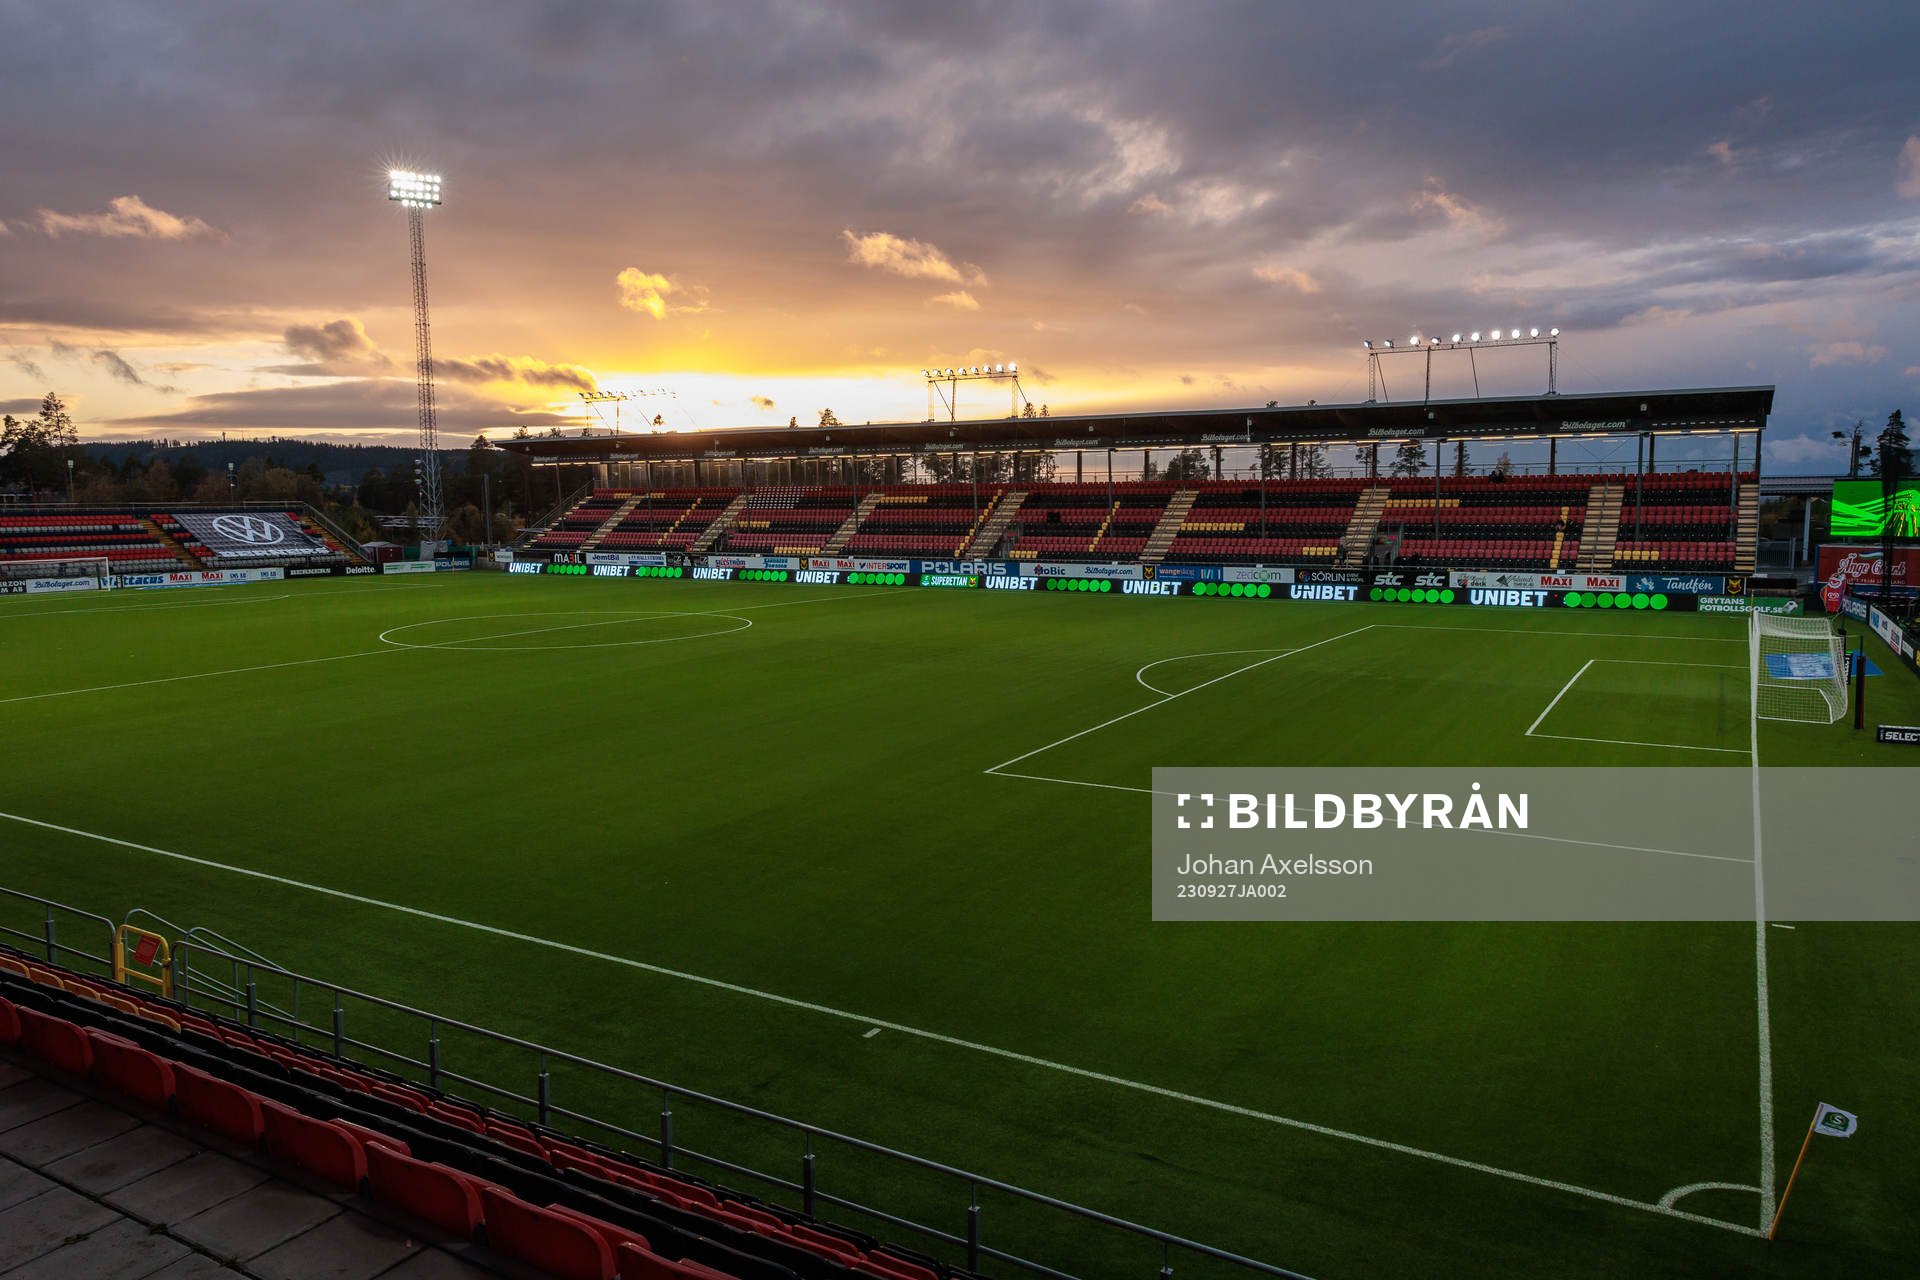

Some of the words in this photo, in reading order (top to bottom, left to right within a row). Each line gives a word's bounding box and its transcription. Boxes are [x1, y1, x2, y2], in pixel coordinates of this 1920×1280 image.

[1560, 420, 1626, 430] Bilbolaget.com
[509, 562, 542, 574] UNIBET
[593, 565, 630, 577] UNIBET
[866, 562, 908, 571] INTERSPORT
[921, 561, 1007, 576] POLARIS
[1085, 566, 1133, 577] Bilbolaget.com
[693, 567, 733, 580] UNIBET
[796, 571, 840, 584] UNIBET
[1374, 572, 1404, 586] stc
[1414, 573, 1446, 586] stc
[34, 579, 91, 589] Bilbolaget.com
[931, 576, 967, 586] SUPERETTAN
[985, 576, 1038, 590] UNIBET
[1540, 576, 1573, 587] MAXI
[1587, 577, 1620, 588] MAXI
[1661, 577, 1713, 594] Tandfén
[1122, 580, 1182, 595] UNIBET
[1290, 584, 1358, 600] UNIBET
[1470, 589, 1548, 607] UNIBET
[1700, 597, 1745, 605] GRYTANS
